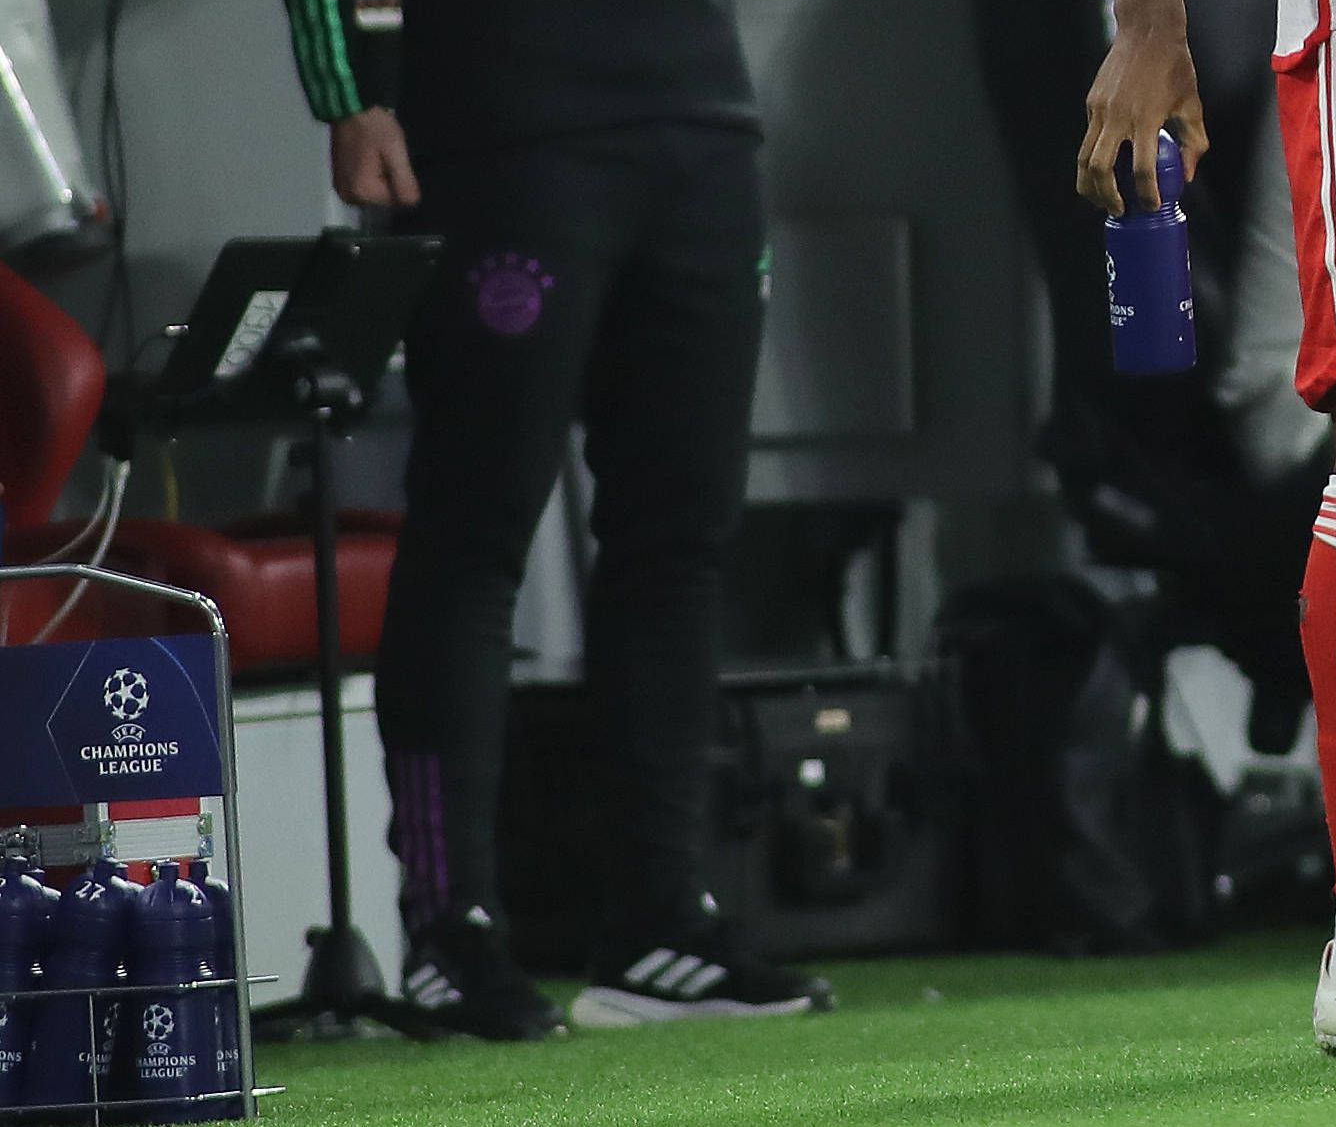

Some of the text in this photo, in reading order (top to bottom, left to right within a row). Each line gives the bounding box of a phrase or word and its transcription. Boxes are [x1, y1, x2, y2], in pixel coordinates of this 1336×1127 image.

[112, 726, 144, 740] UEFA
[80, 741, 179, 760] CHAMPIONS
[99, 758, 163, 776] LEAGUE
[140, 1067, 184, 1079] LEAGUE
